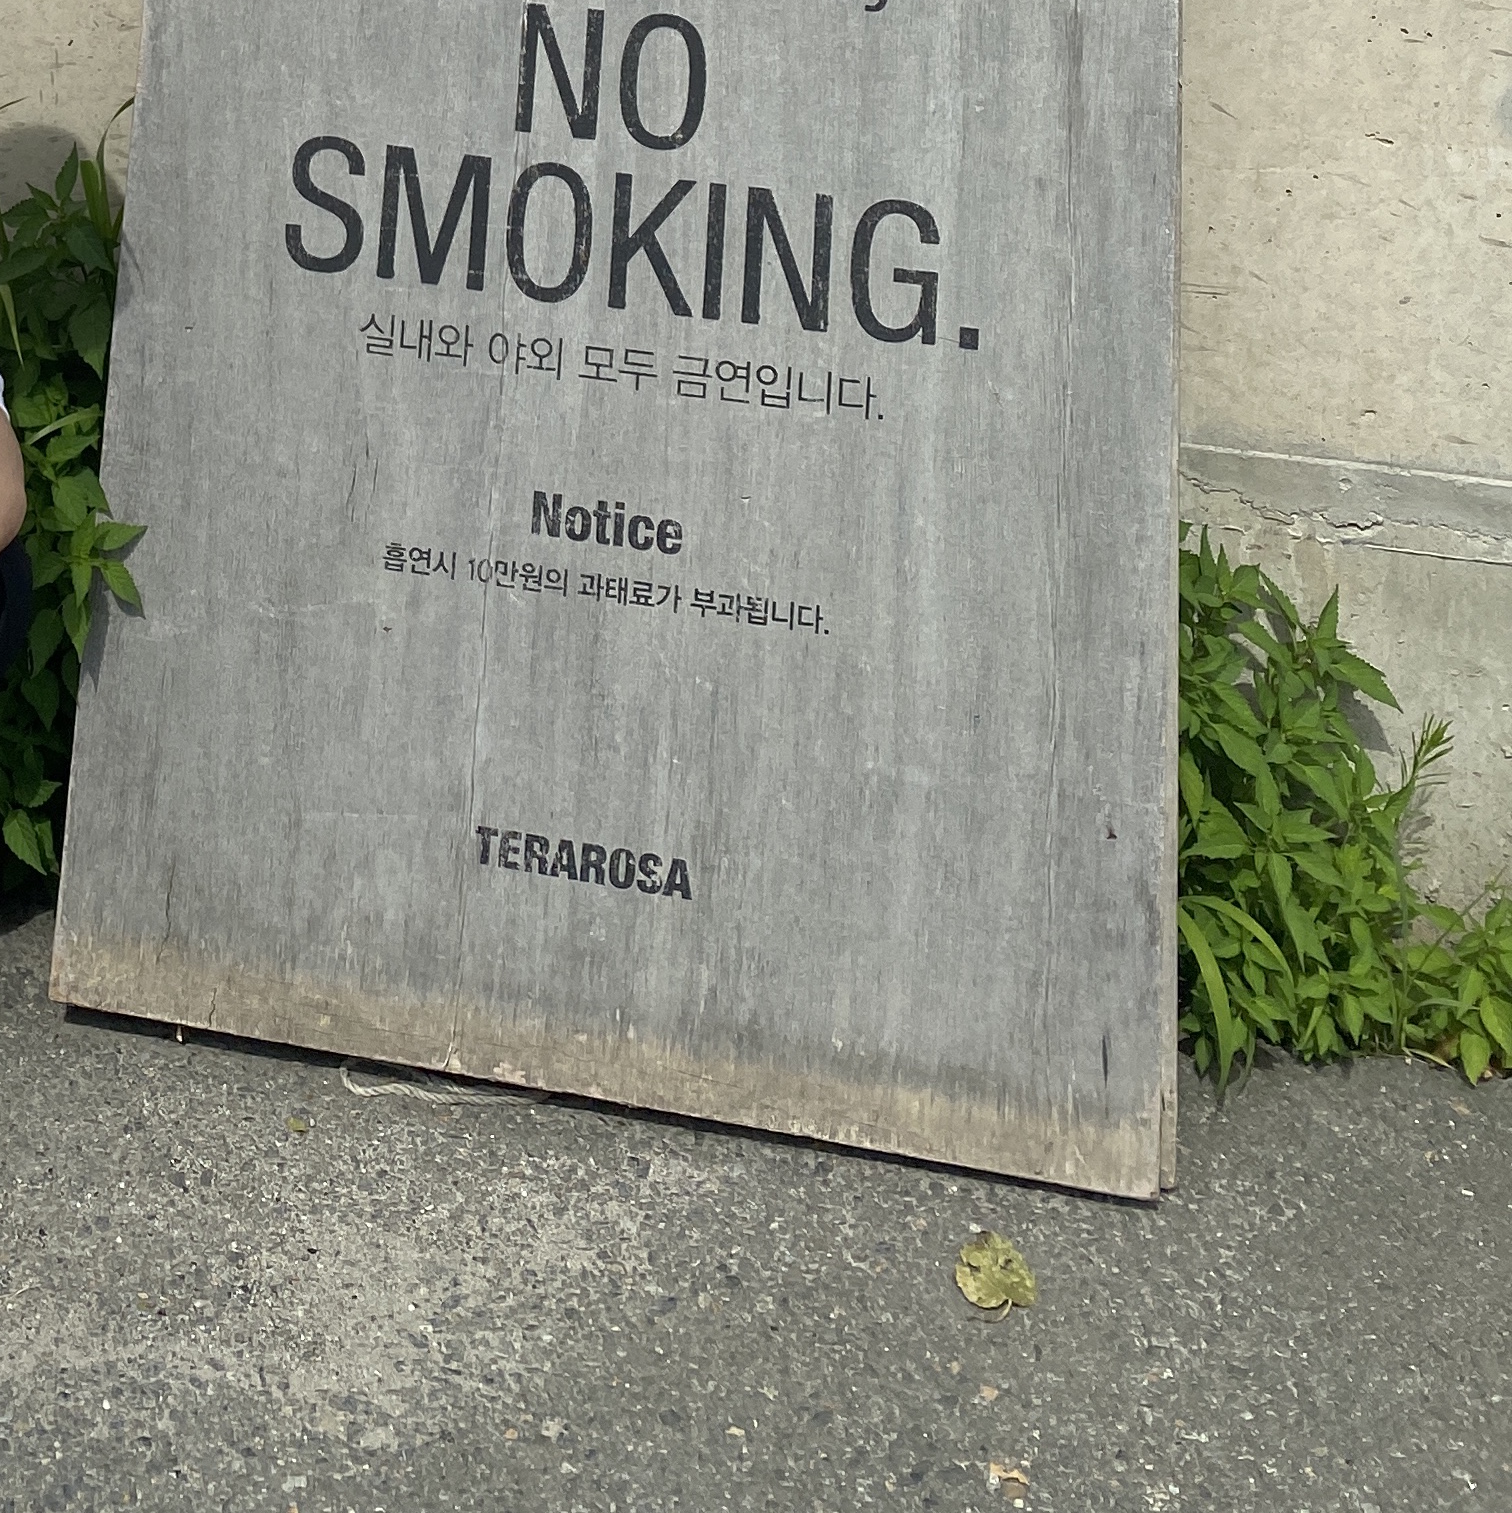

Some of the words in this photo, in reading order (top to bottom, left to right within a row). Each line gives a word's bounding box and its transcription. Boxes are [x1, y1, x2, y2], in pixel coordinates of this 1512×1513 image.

[514, 2, 707, 151] NO
[284, 135, 981, 352] SMOKING.
[358, 313, 475, 368] 실내와
[488, 332, 564, 381] 야외
[577, 345, 659, 392] 모두
[672, 354, 886, 421] 금연입니다.
[530, 490, 684, 556] Notice
[382, 543, 458, 581] 흡연시
[468, 557, 570, 599] 10만원의
[577, 573, 684, 614] 과태료가
[689, 587, 830, 636] 부과됩니다.
[474, 825, 694, 901] TERAROSA
